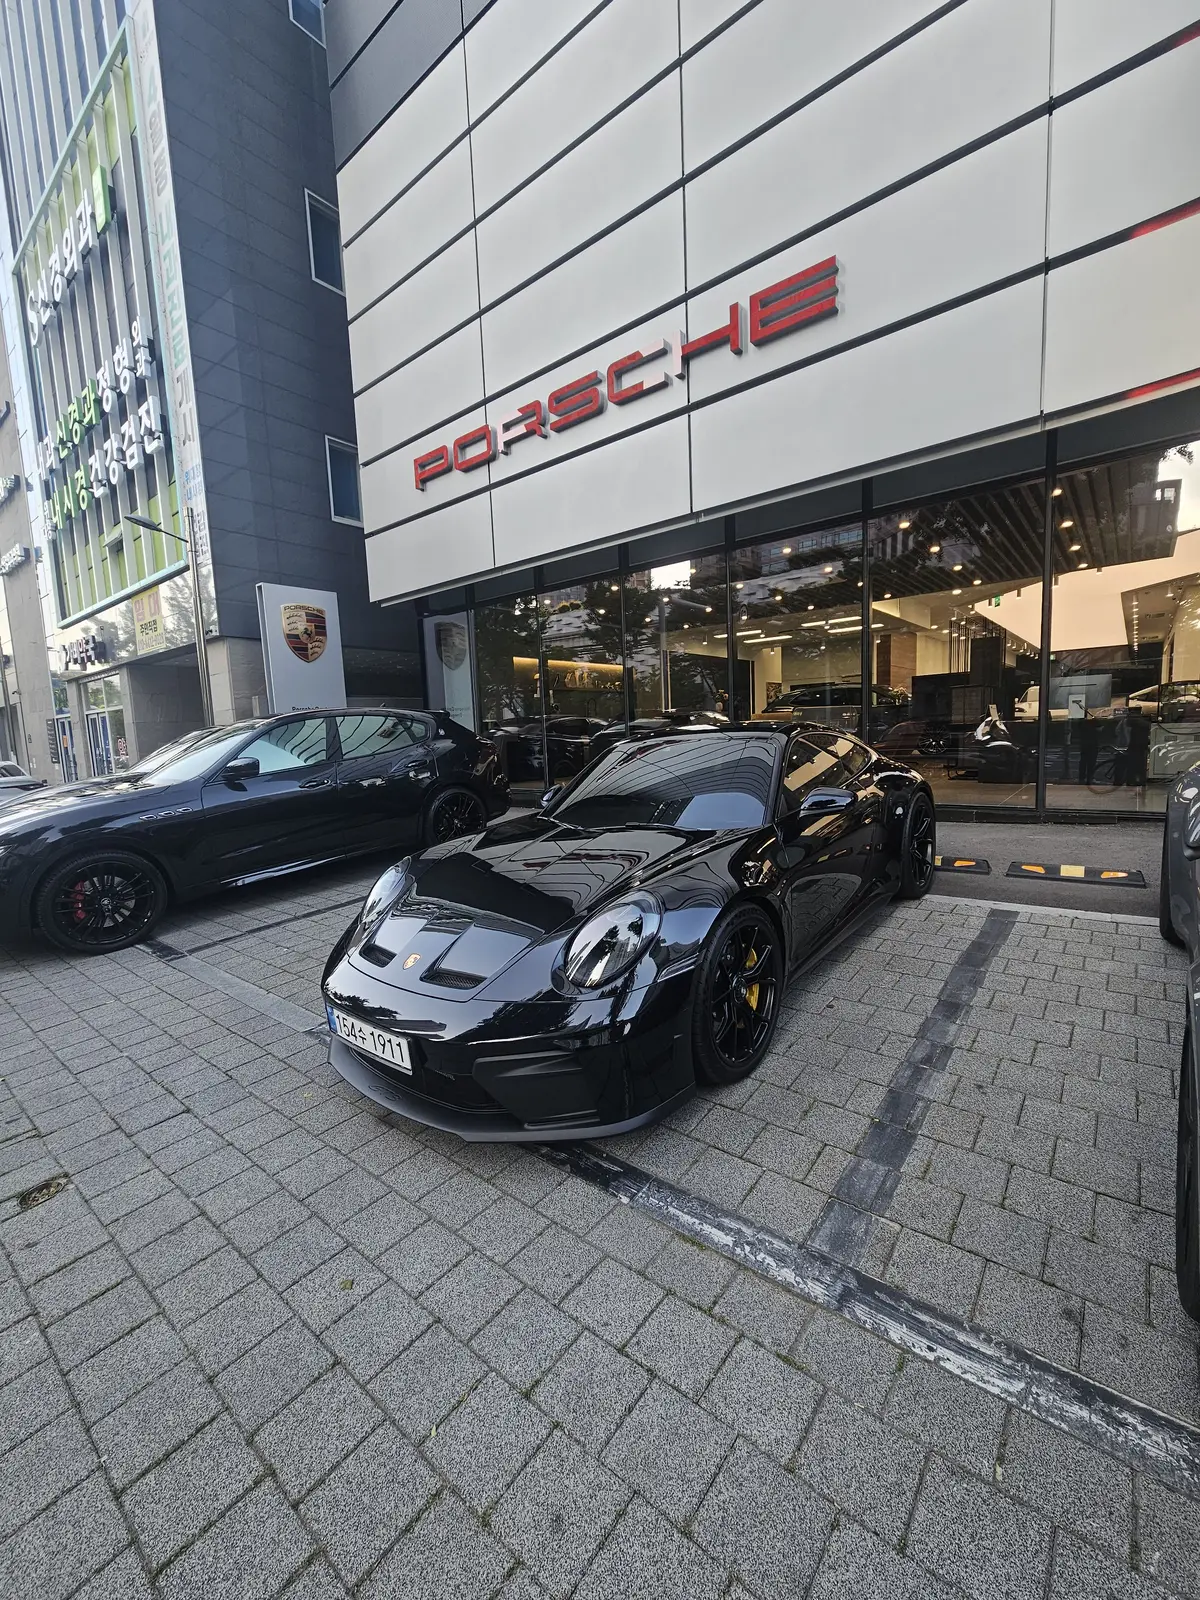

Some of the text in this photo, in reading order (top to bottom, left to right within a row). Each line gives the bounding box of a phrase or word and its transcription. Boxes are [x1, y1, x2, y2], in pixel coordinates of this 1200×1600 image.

[56, 378, 100, 459] 신경과
[96, 315, 151, 413] 정형외과
[413, 255, 839, 492] PORSCHE
[50, 465, 92, 529] 내시경
[88, 395, 164, 498] 건강검진
[284, 604, 326, 616] PORSCHE
[335, 1014, 405, 1063] 154수 1911
